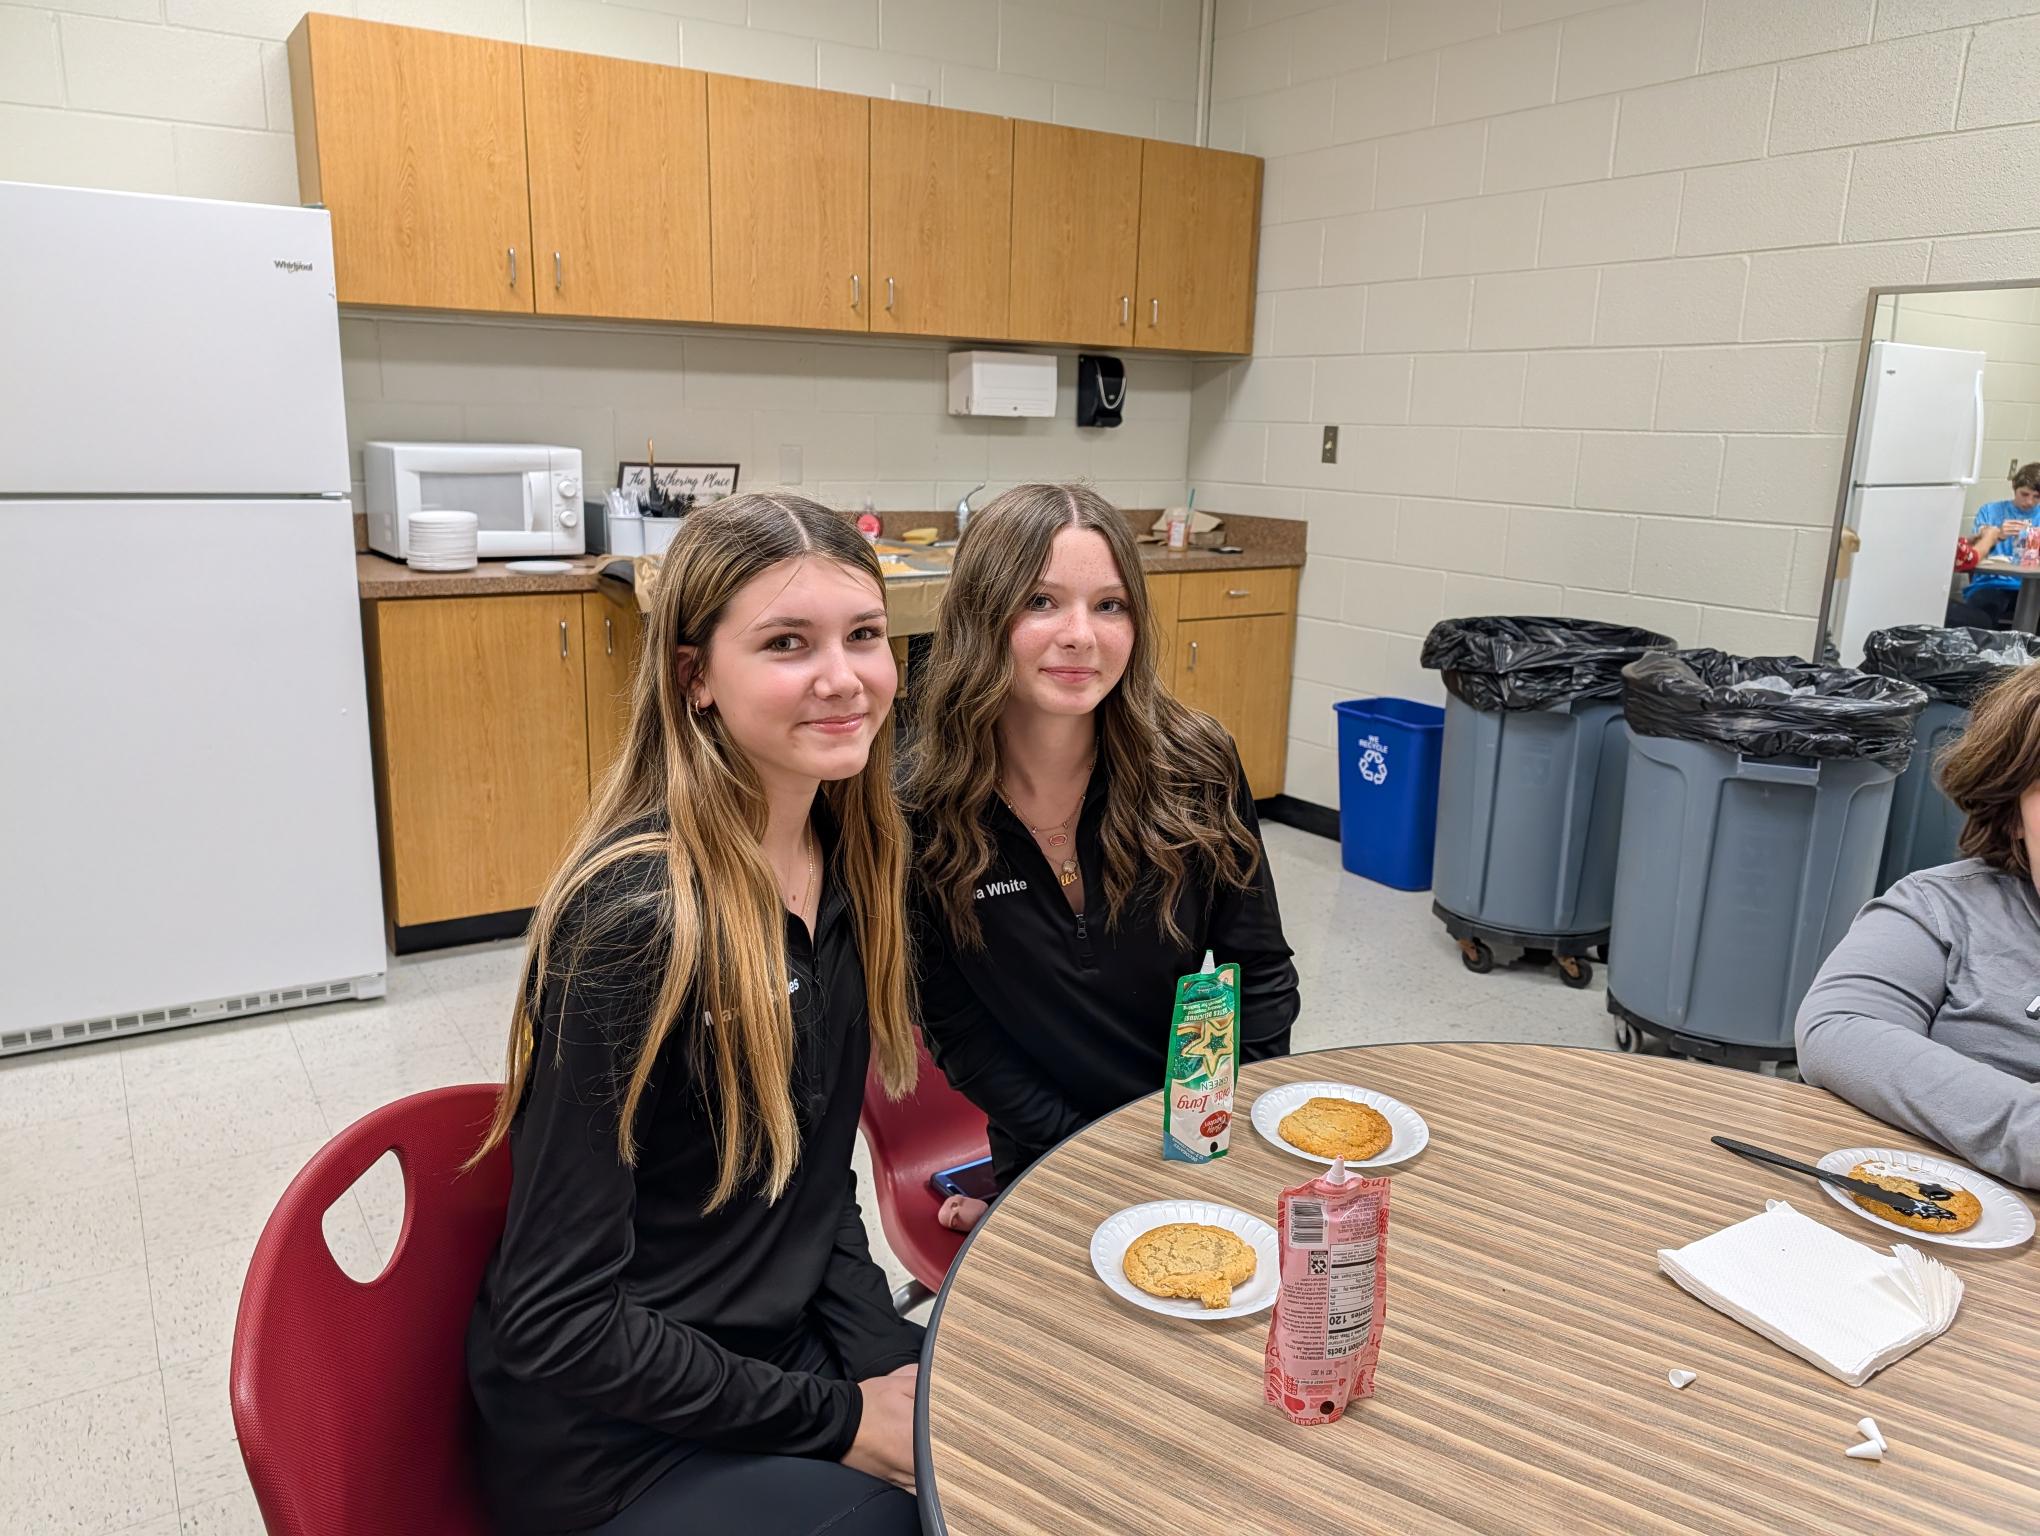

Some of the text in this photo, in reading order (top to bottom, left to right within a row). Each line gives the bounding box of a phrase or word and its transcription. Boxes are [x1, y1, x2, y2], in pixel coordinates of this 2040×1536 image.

[273, 260, 313, 272] Whirlpool
[627, 470, 646, 486] The
[702, 472, 730, 488] Place
[986, 878, 1028, 897] White
[1200, 1077, 1229, 1092] GREEN
[1177, 1094, 1210, 1114] Icing
[1329, 1315, 1347, 1326] 120
[1327, 1346, 1346, 1357] Facts
